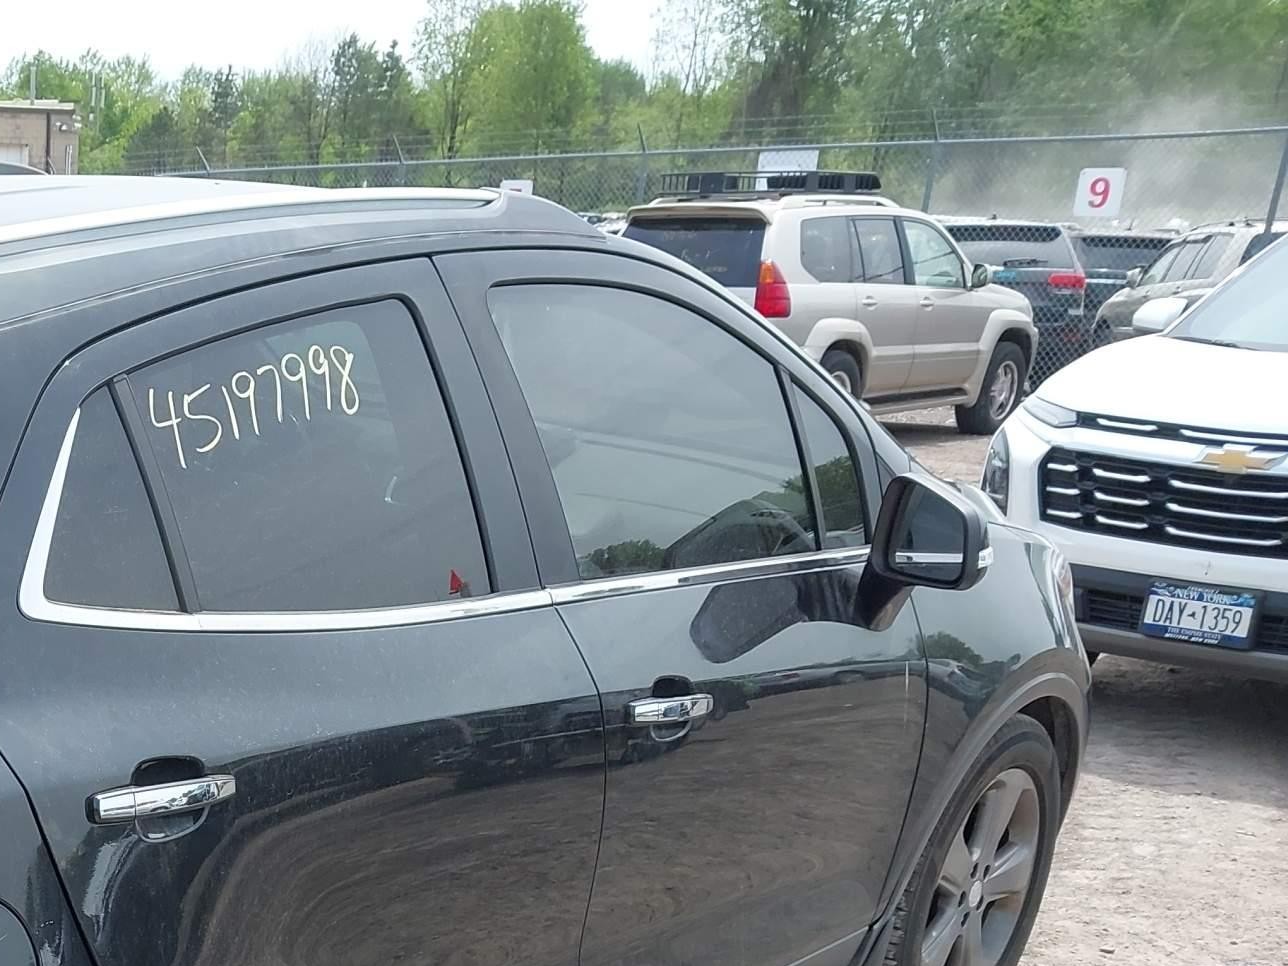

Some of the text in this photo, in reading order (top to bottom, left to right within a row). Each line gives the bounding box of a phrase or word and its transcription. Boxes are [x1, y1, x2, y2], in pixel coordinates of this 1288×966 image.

[1088, 177, 1111, 208] 9
[148, 344, 360, 470] 45197998
[1174, 588, 1200, 601] NEW
[1202, 592, 1232, 605] YORK
[1152, 598, 1243, 634] DAY 1359
